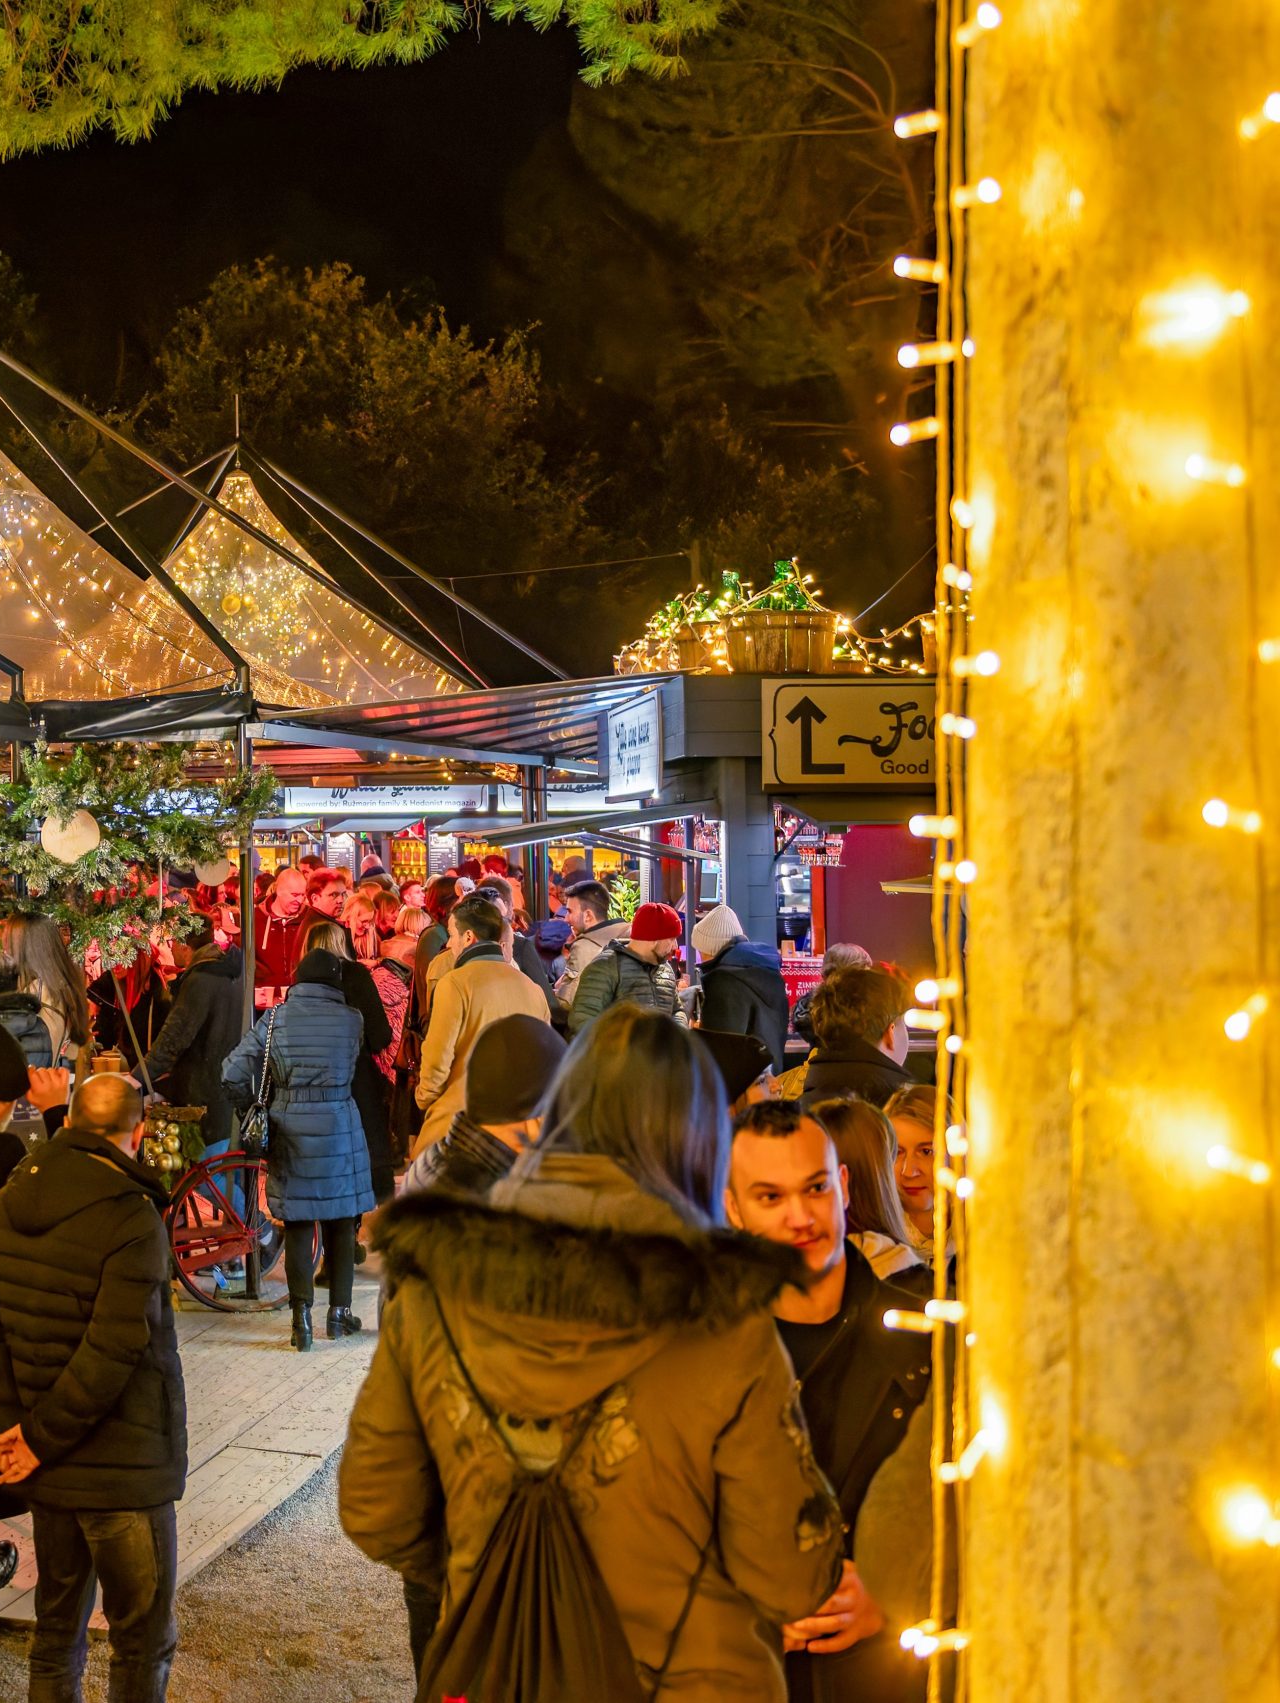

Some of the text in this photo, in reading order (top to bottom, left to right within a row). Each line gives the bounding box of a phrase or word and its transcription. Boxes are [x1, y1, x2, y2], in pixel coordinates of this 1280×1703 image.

[880, 759, 929, 775] Good
[296, 799, 477, 808] powered by: Ružmarin family & Hedonist magazin
